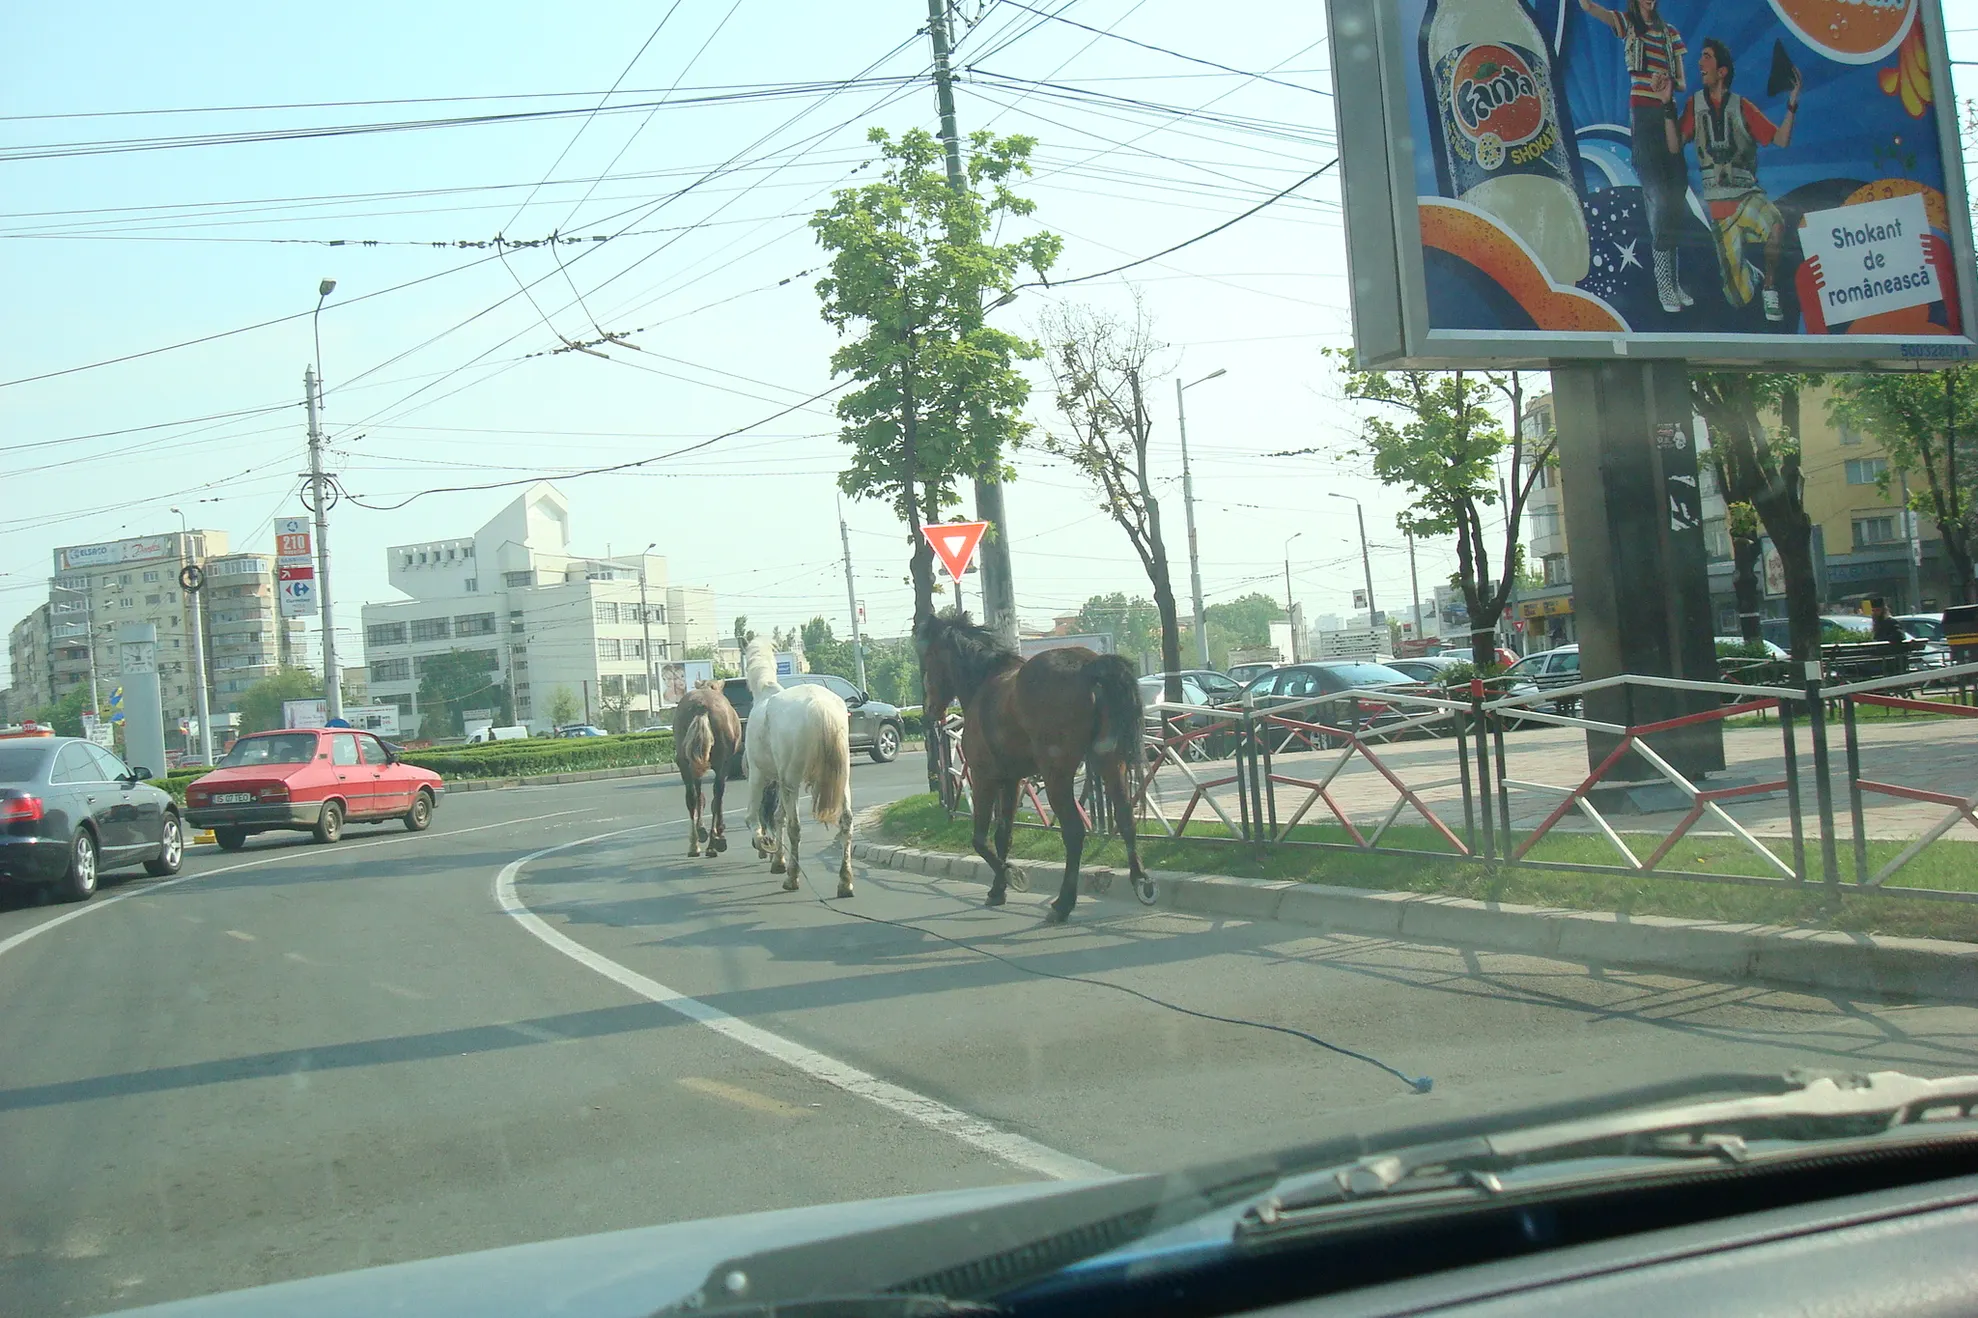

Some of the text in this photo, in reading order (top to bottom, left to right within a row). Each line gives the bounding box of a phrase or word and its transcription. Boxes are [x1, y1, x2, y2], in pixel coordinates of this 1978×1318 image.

[1457, 66, 1539, 129] Fanta
[1831, 218, 1902, 249] Shokant
[1863, 250, 1886, 271] de
[1828, 265, 1931, 307] românească
[283, 535, 306, 550] 210
